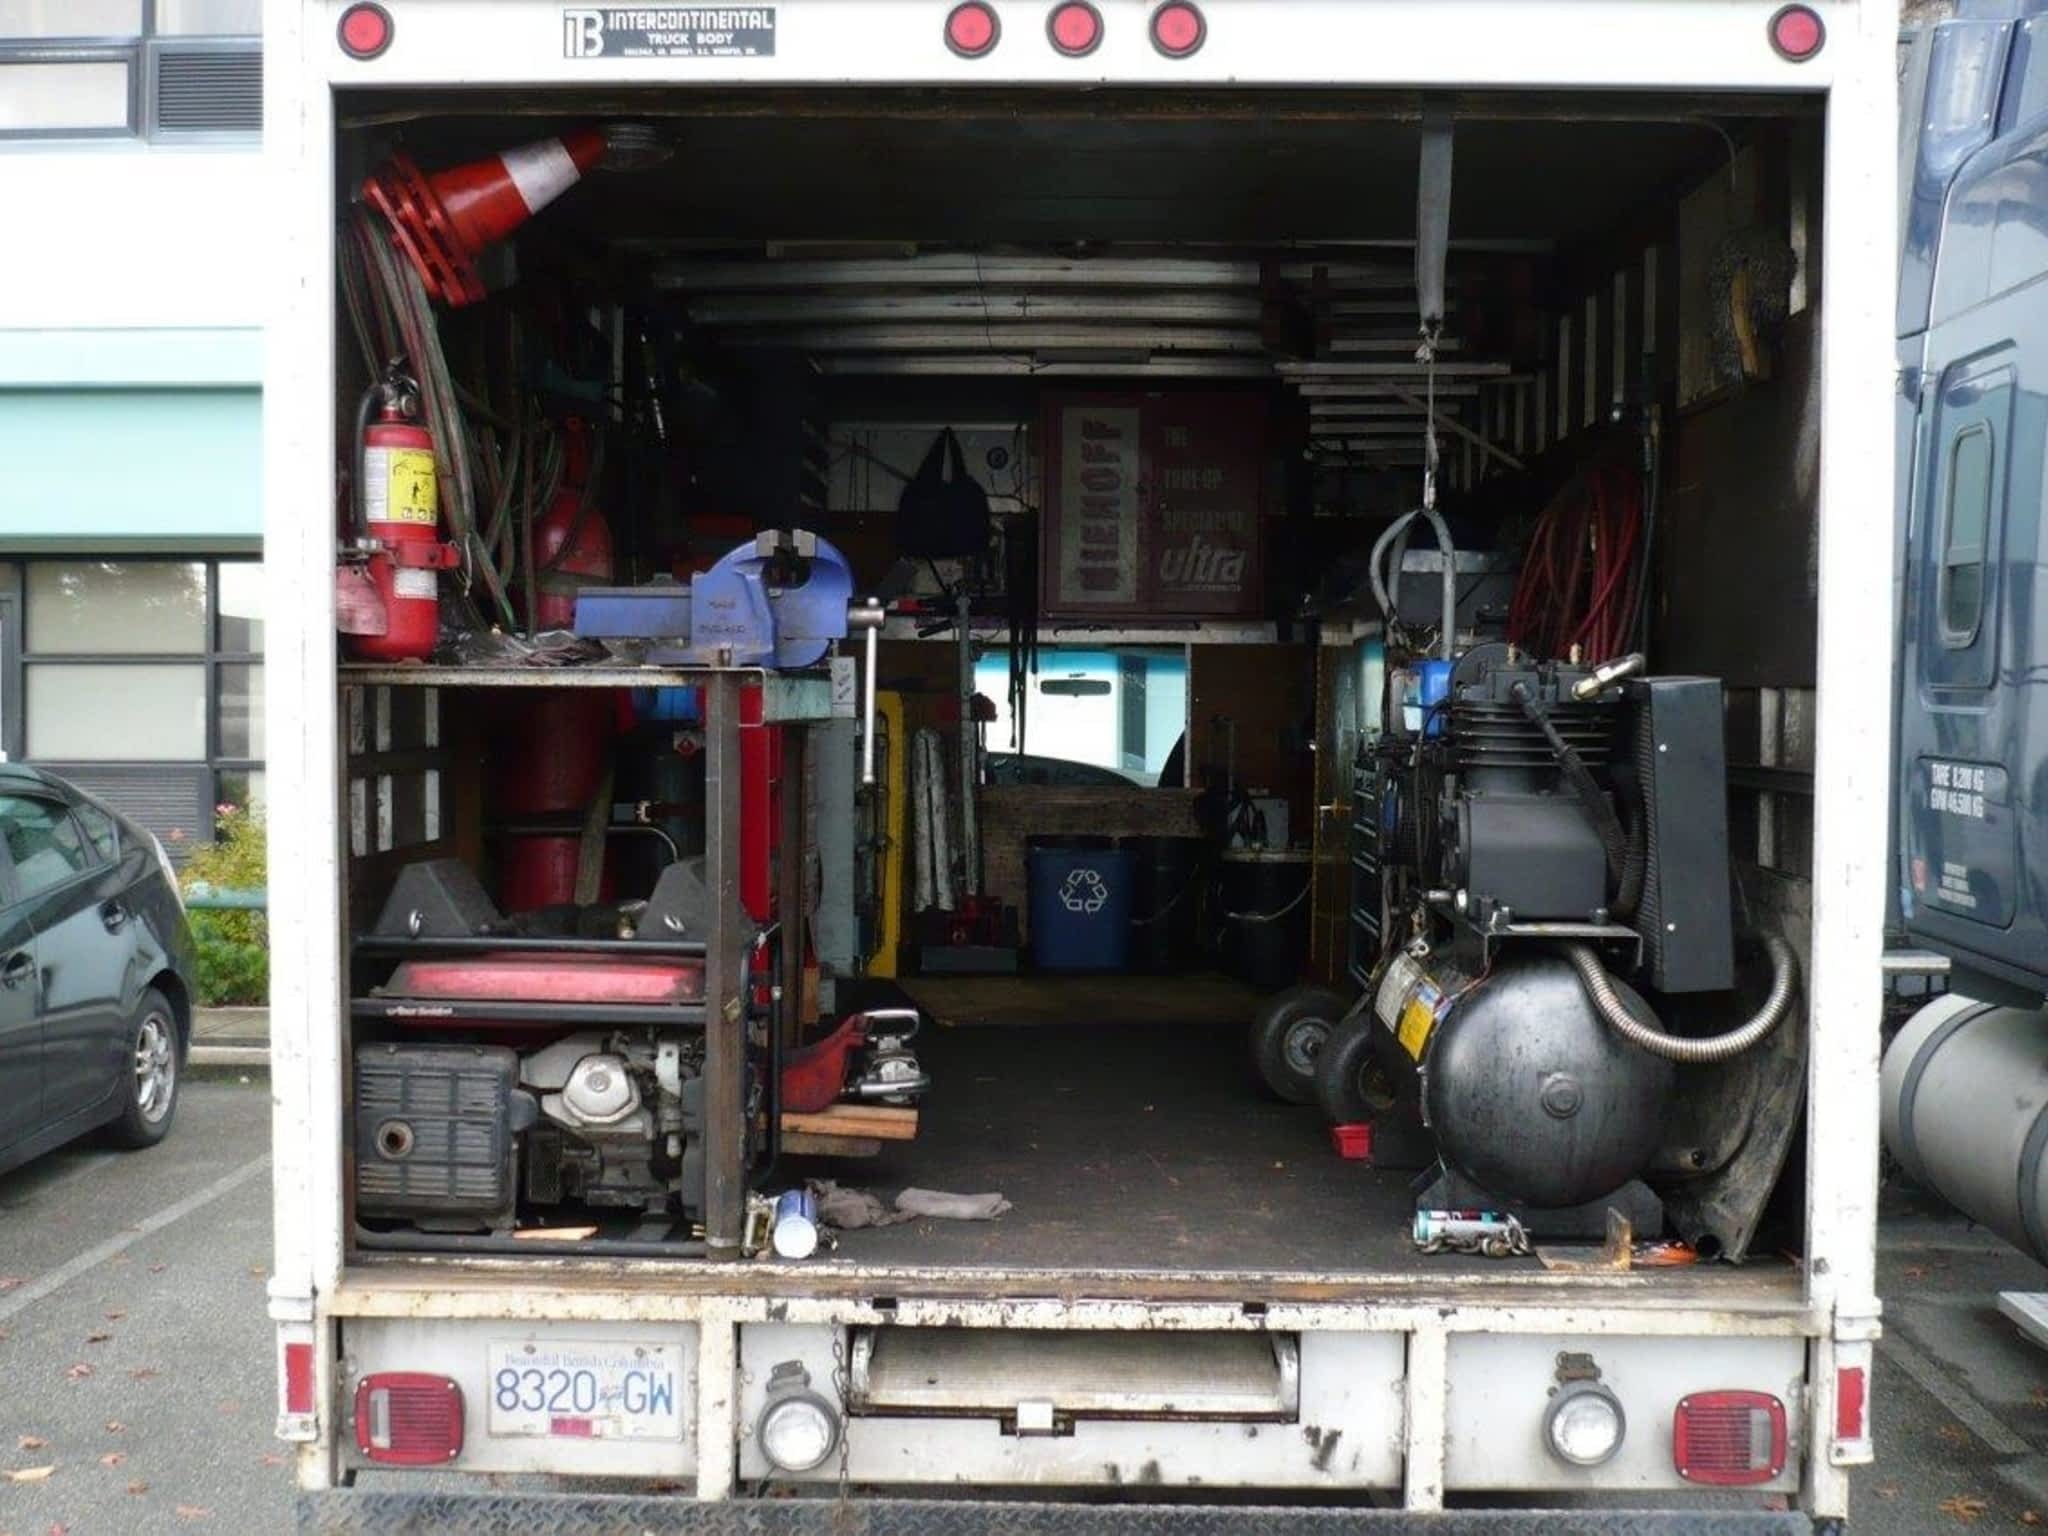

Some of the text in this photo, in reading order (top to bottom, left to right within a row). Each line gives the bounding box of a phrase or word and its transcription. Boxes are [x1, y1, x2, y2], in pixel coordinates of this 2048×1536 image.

[607, 10, 773, 30] INTERCONTINENTAL
[646, 32, 734, 45] TRUCK BODY
[495, 1368, 673, 1416] 8320 GW
